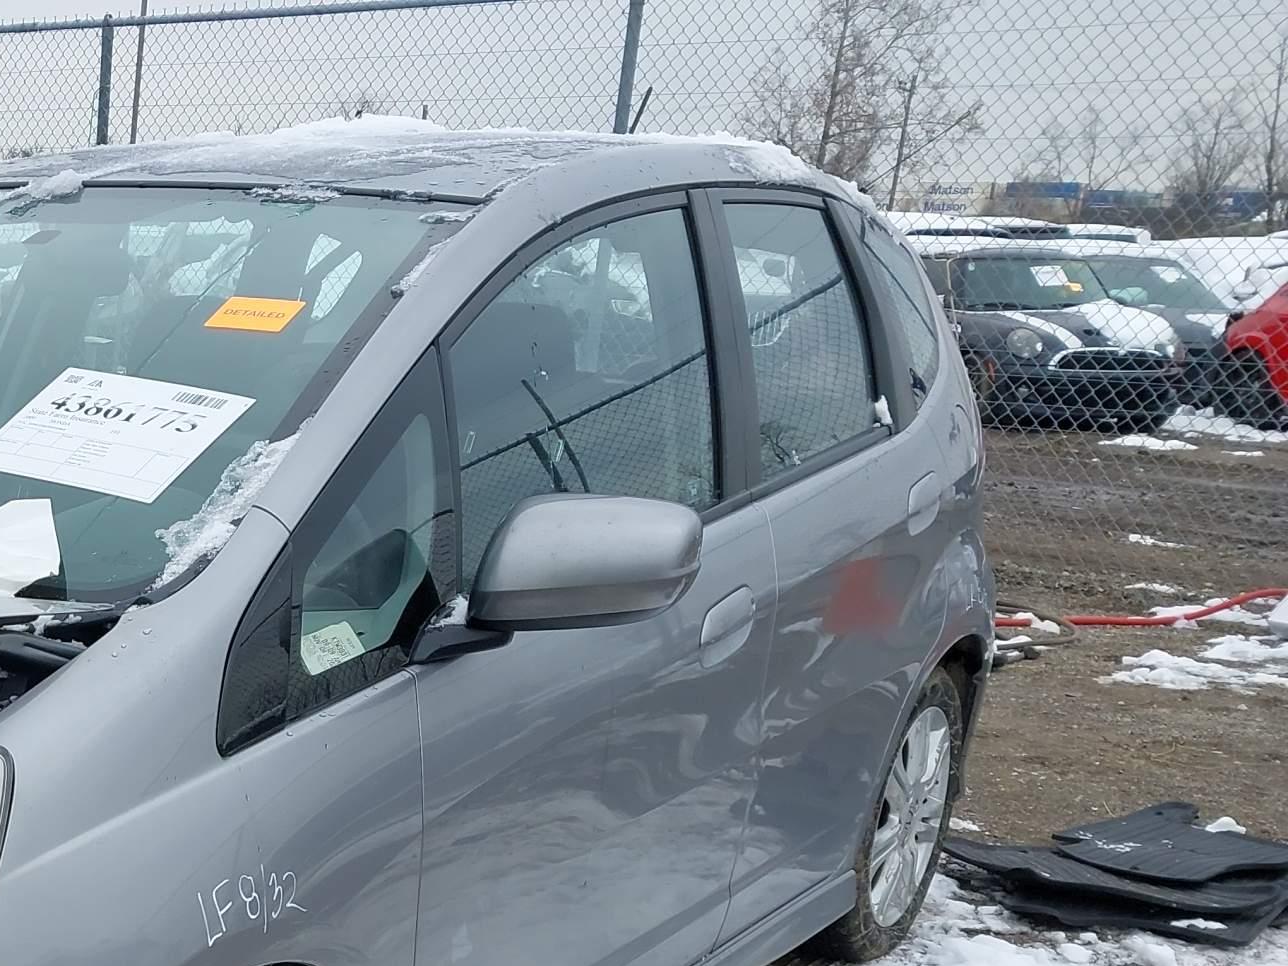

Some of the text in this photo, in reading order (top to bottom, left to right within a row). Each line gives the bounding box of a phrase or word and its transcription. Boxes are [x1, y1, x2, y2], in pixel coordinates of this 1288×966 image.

[929, 184, 973, 195] Matson
[923, 201, 967, 212] Matson
[223, 308, 286, 319] DETAILED
[50, 392, 207, 433] 43861775
[197, 863, 309, 948] LF 8/32
